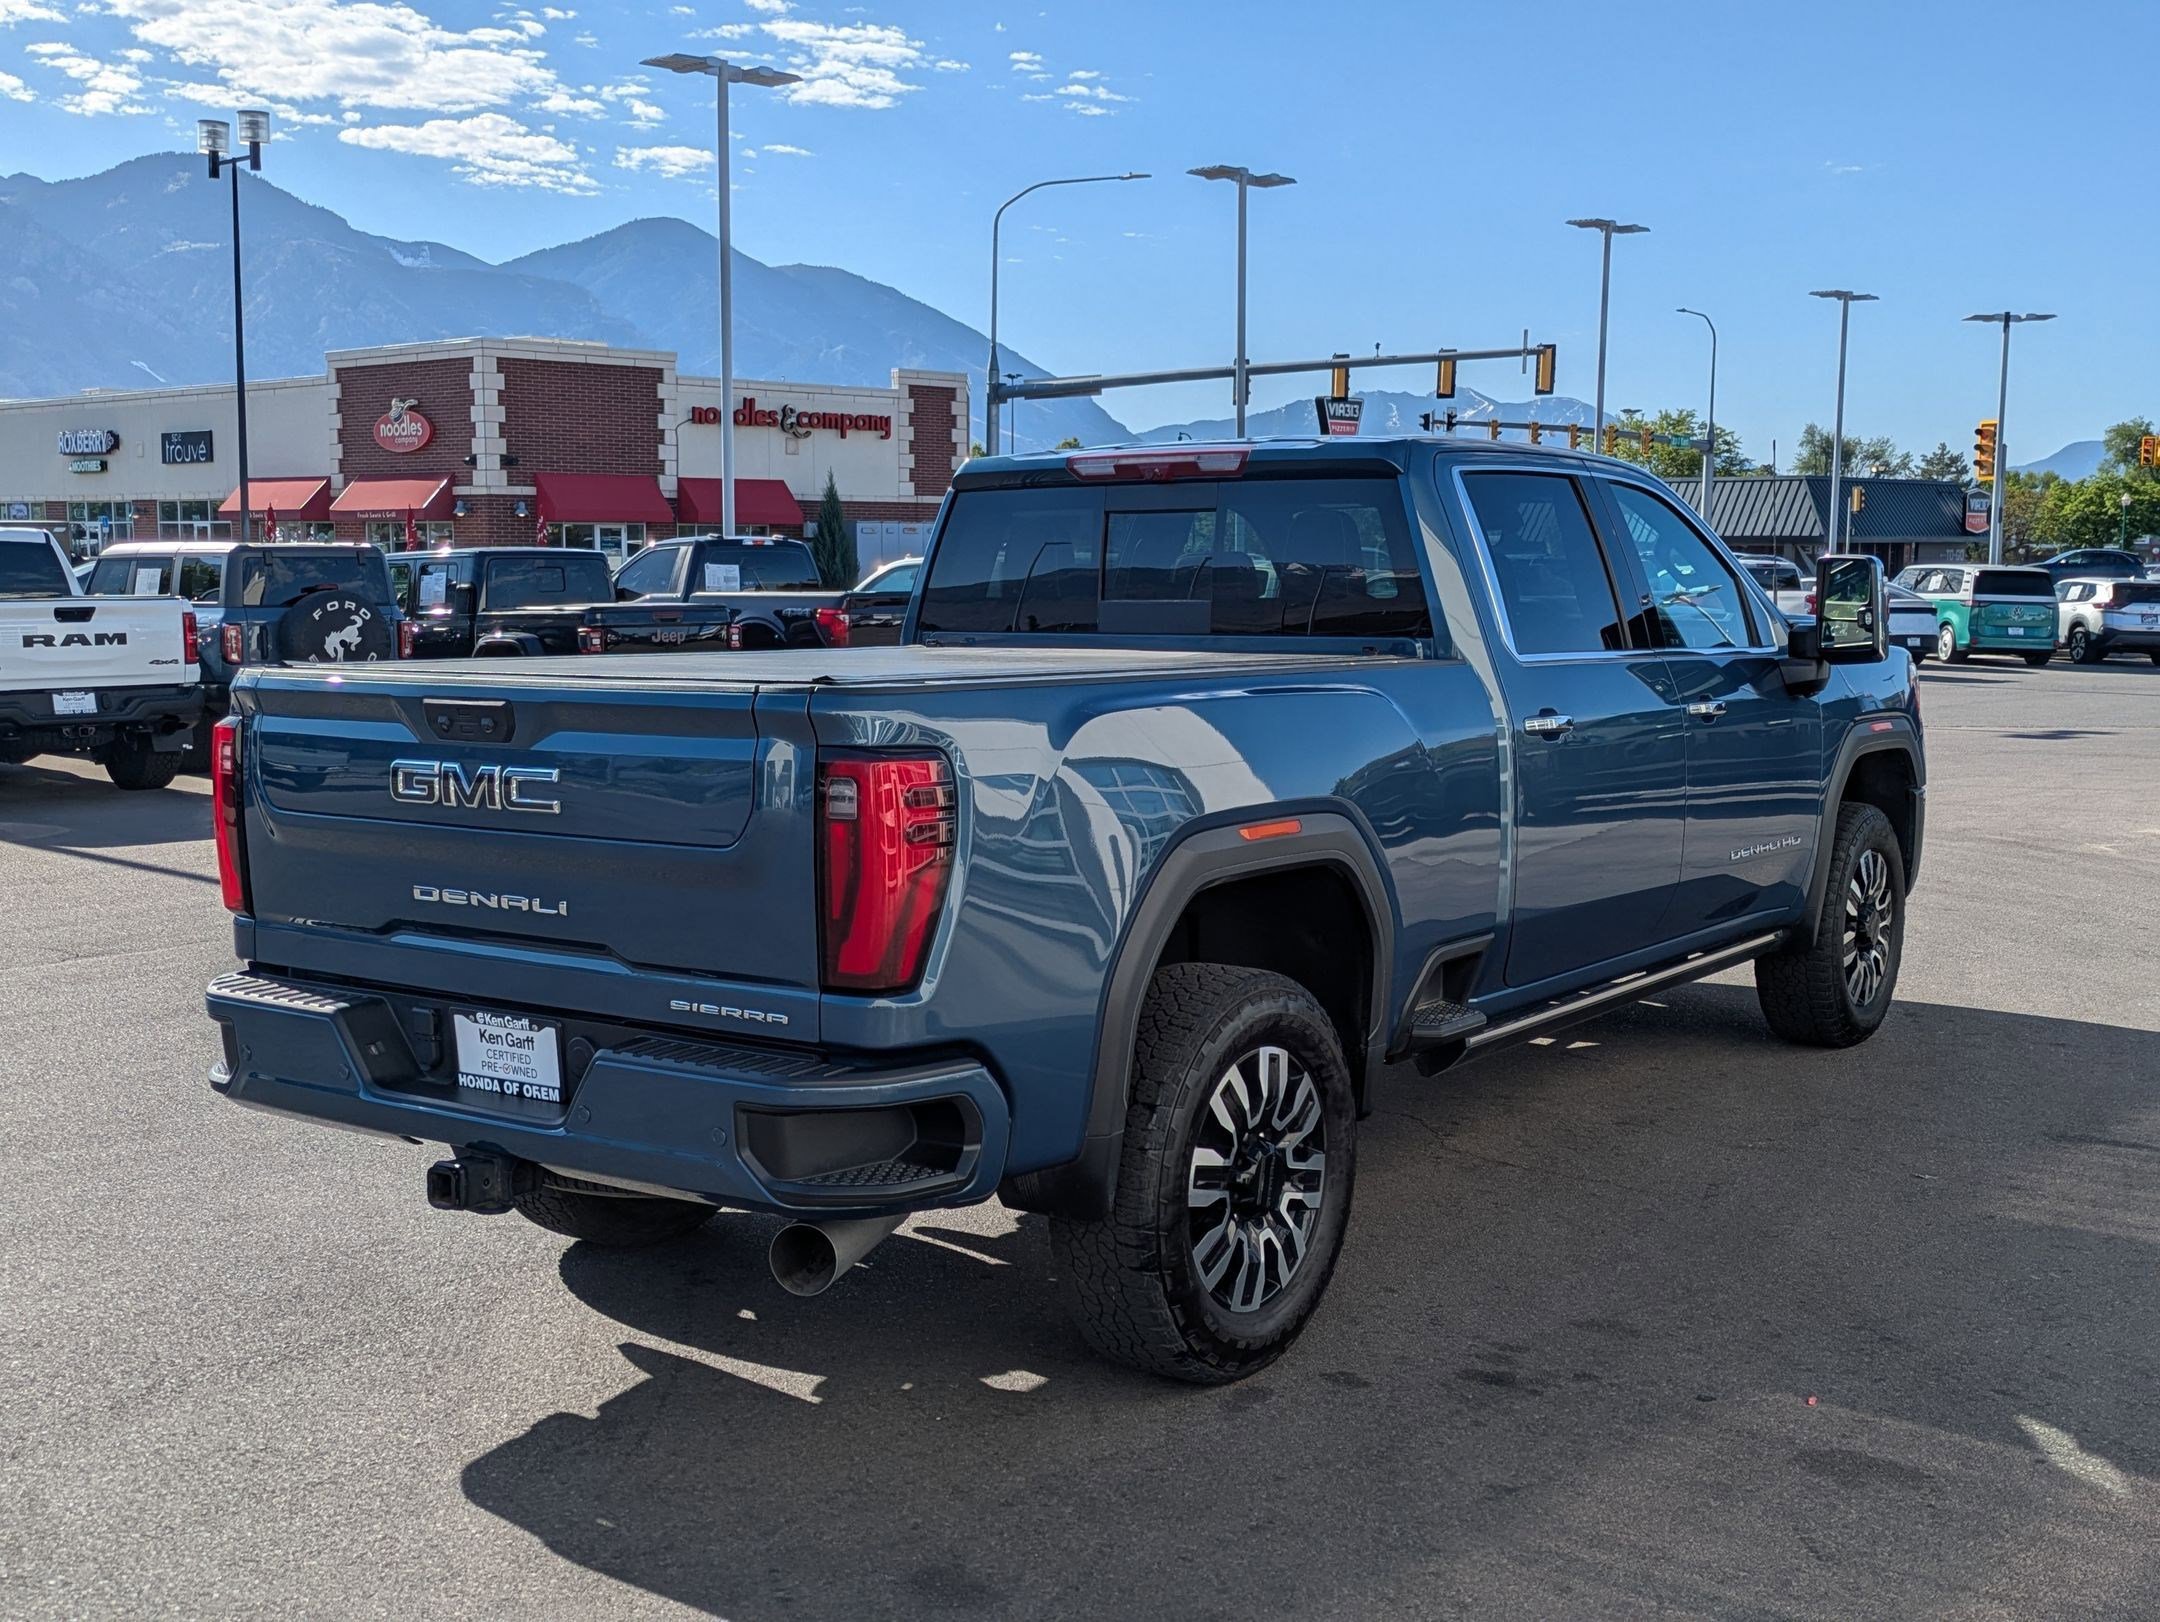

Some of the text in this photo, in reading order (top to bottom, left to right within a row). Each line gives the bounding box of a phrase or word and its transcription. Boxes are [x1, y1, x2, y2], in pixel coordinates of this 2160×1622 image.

[691, 397, 779, 427] nodles
[797, 411, 891, 440] company
[1328, 402, 1360, 417] VIA313
[380, 415, 423, 437] noodles
[58, 430, 107, 453] ROXBERRY
[165, 440, 207, 463] trouvé
[312, 600, 371, 621] FORD
[22, 632, 127, 648] RAM
[651, 629, 686, 645] Jeep
[389, 758, 561, 815] GMC
[413, 885, 567, 916] DENALI
[484, 1013, 530, 1031] Ken Garff
[670, 1000, 789, 1025] SIERRA
[479, 1028, 535, 1051] Ken Garff
[486, 1048, 532, 1065] CERTIFIED
[458, 1073, 560, 1103] HONDA OF OREM
